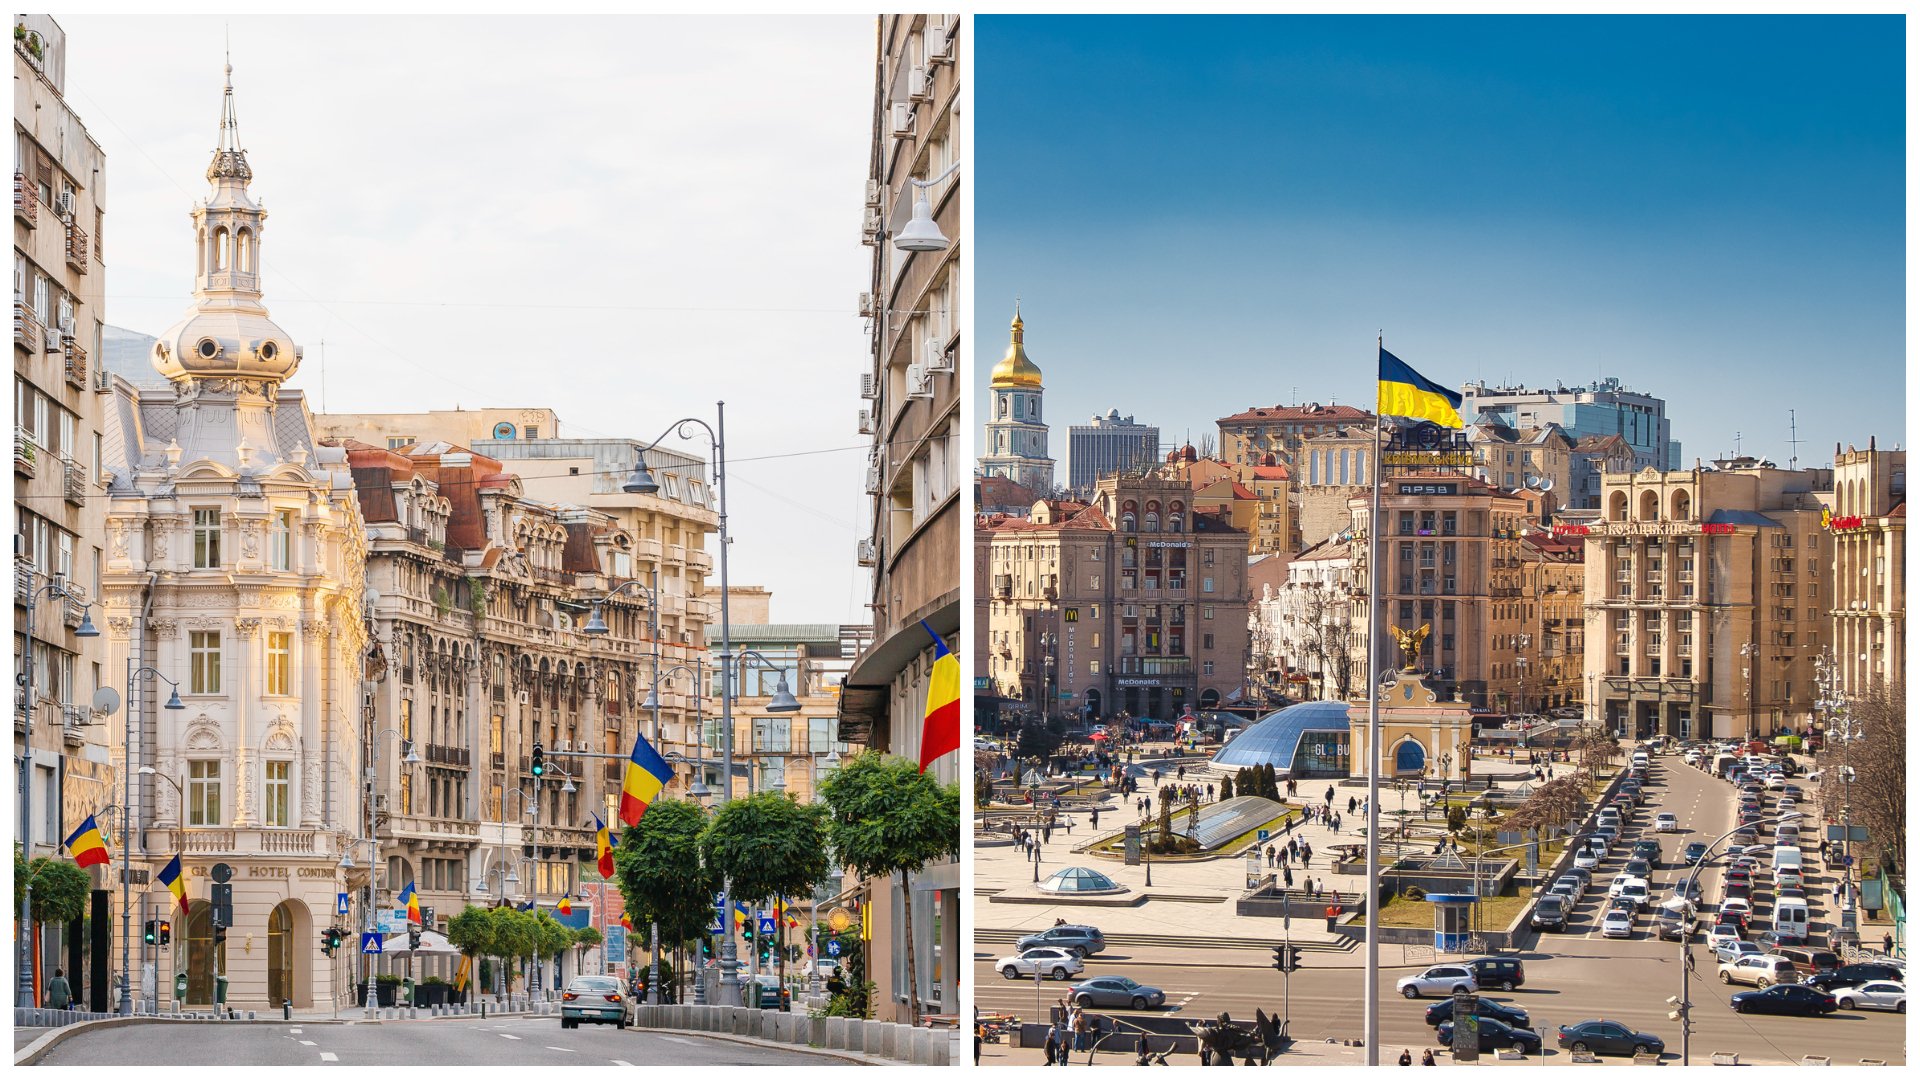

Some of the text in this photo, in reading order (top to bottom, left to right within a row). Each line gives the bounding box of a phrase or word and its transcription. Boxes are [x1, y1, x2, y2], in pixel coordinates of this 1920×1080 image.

[1401, 485, 1448, 494] APSB
[191, 866, 238, 877] GRD
[249, 866, 292, 878] HOTEL
